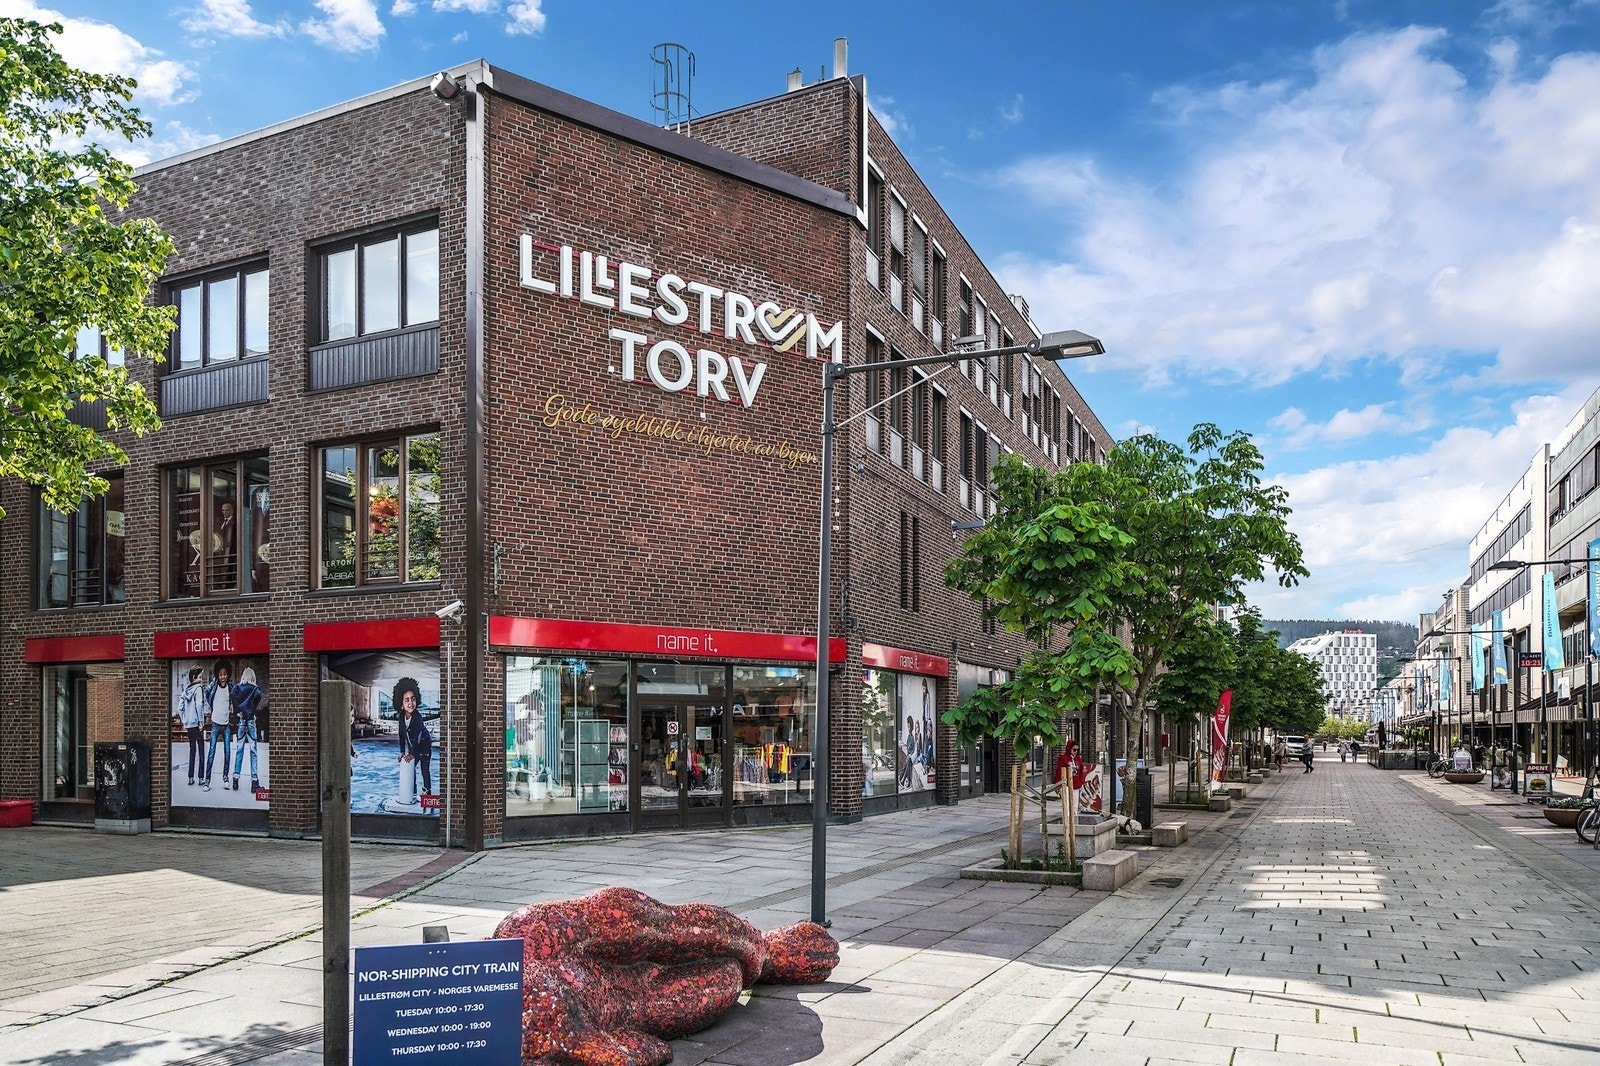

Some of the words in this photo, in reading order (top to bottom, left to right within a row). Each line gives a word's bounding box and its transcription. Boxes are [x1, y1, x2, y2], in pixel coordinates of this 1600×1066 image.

[608, 327, 768, 408] TORV
[543, 393, 599, 428] Gode
[602, 413, 683, 439] øyeblikk
[686, 425, 696, 443] i
[698, 425, 752, 456] hjertet
[754, 443, 775, 456] av
[779, 440, 819, 469] byen
[186, 637, 219, 653] name
[222, 633, 235, 652] it.
[657, 634, 699, 651] name
[704, 633, 718, 653] it.
[900, 655, 913, 669] name
[1521, 659, 1541, 667] 10:21
[358, 966, 449, 983] NOR-SHIPPING
[451, 964, 481, 976] CITY
[483, 961, 520, 974] TRAIN
[359, 991, 410, 1002] LILLESTRØM
[412, 988, 431, 998] CITY
[438, 985, 472, 996] NORGES
[473, 982, 519, 993] VAREMESSE
[395, 1007, 433, 1018] TUESDAY
[435, 1005, 458, 1014] 10:00
[464, 1003, 485, 1012] 17:30
[387, 1025, 439, 1037] WEDNESDAY
[441, 1023, 463, 1032] 10:00
[469, 1021, 492, 1030] 19:00
[392, 1044, 436, 1056] THURSDAY
[437, 1042, 460, 1051] 10:00
[466, 1039, 487, 1049] 17:30
